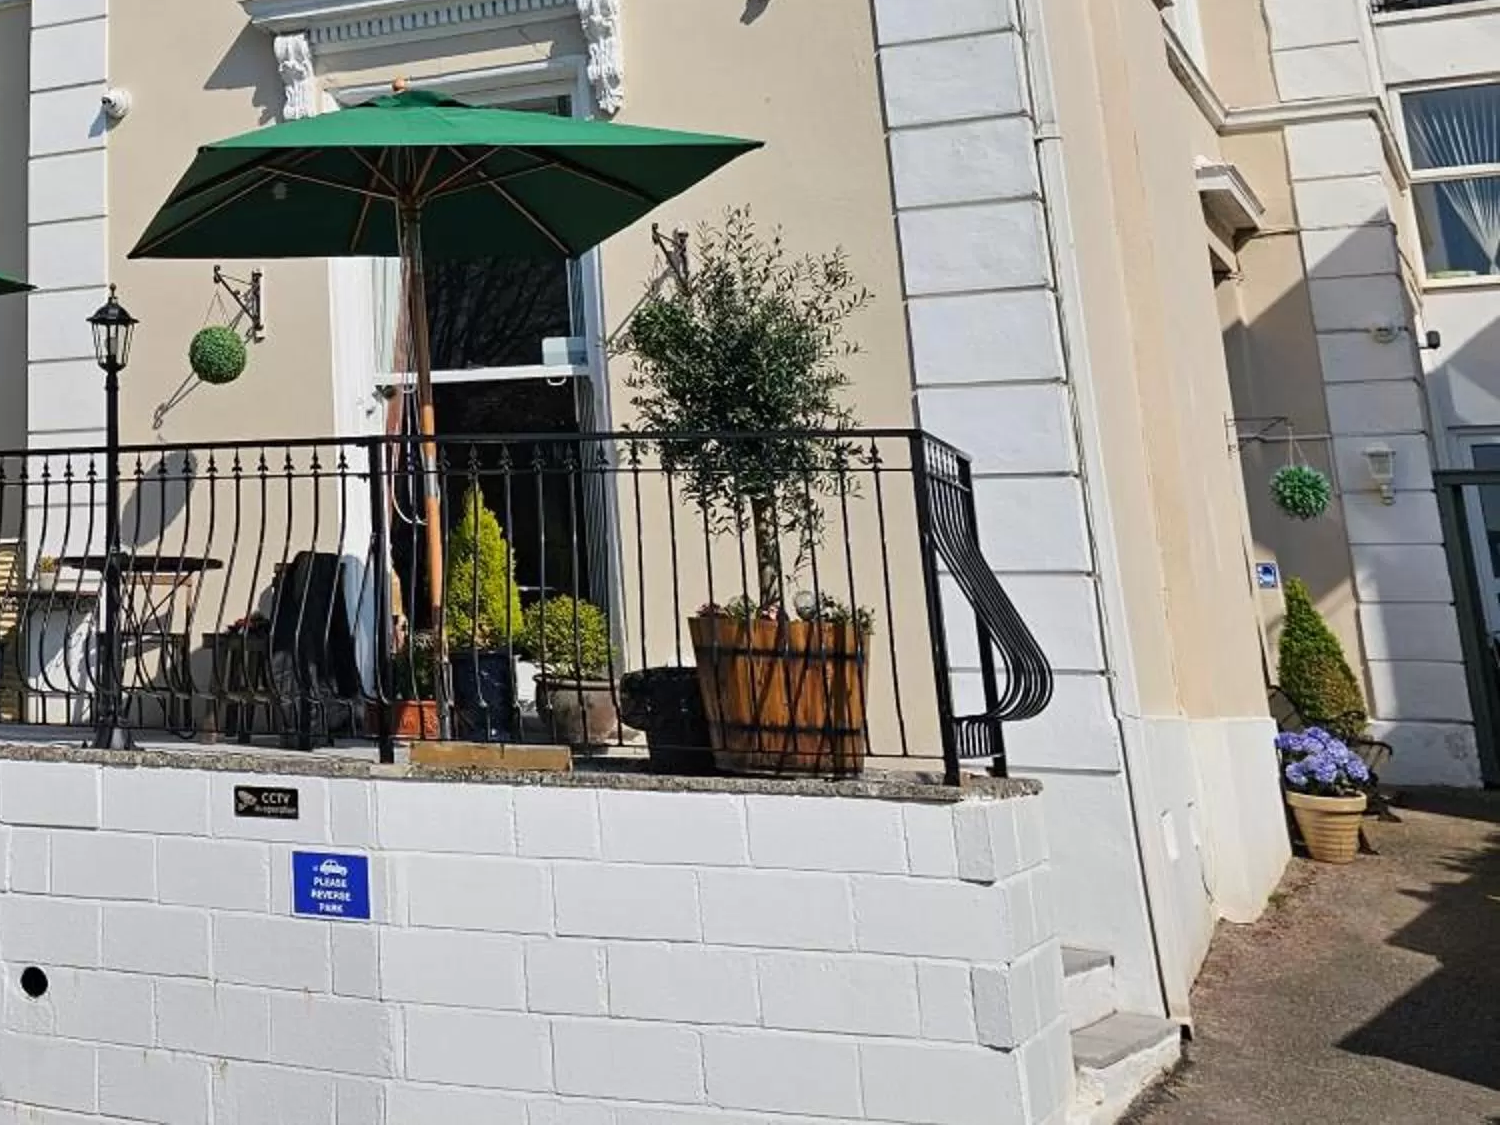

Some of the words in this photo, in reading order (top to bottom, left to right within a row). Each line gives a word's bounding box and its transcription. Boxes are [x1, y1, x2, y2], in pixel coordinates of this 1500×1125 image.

[261, 792, 290, 803] CCTV
[313, 876, 347, 888] PLEASE
[311, 889, 352, 902] REVERSE
[319, 903, 343, 913] PARK
